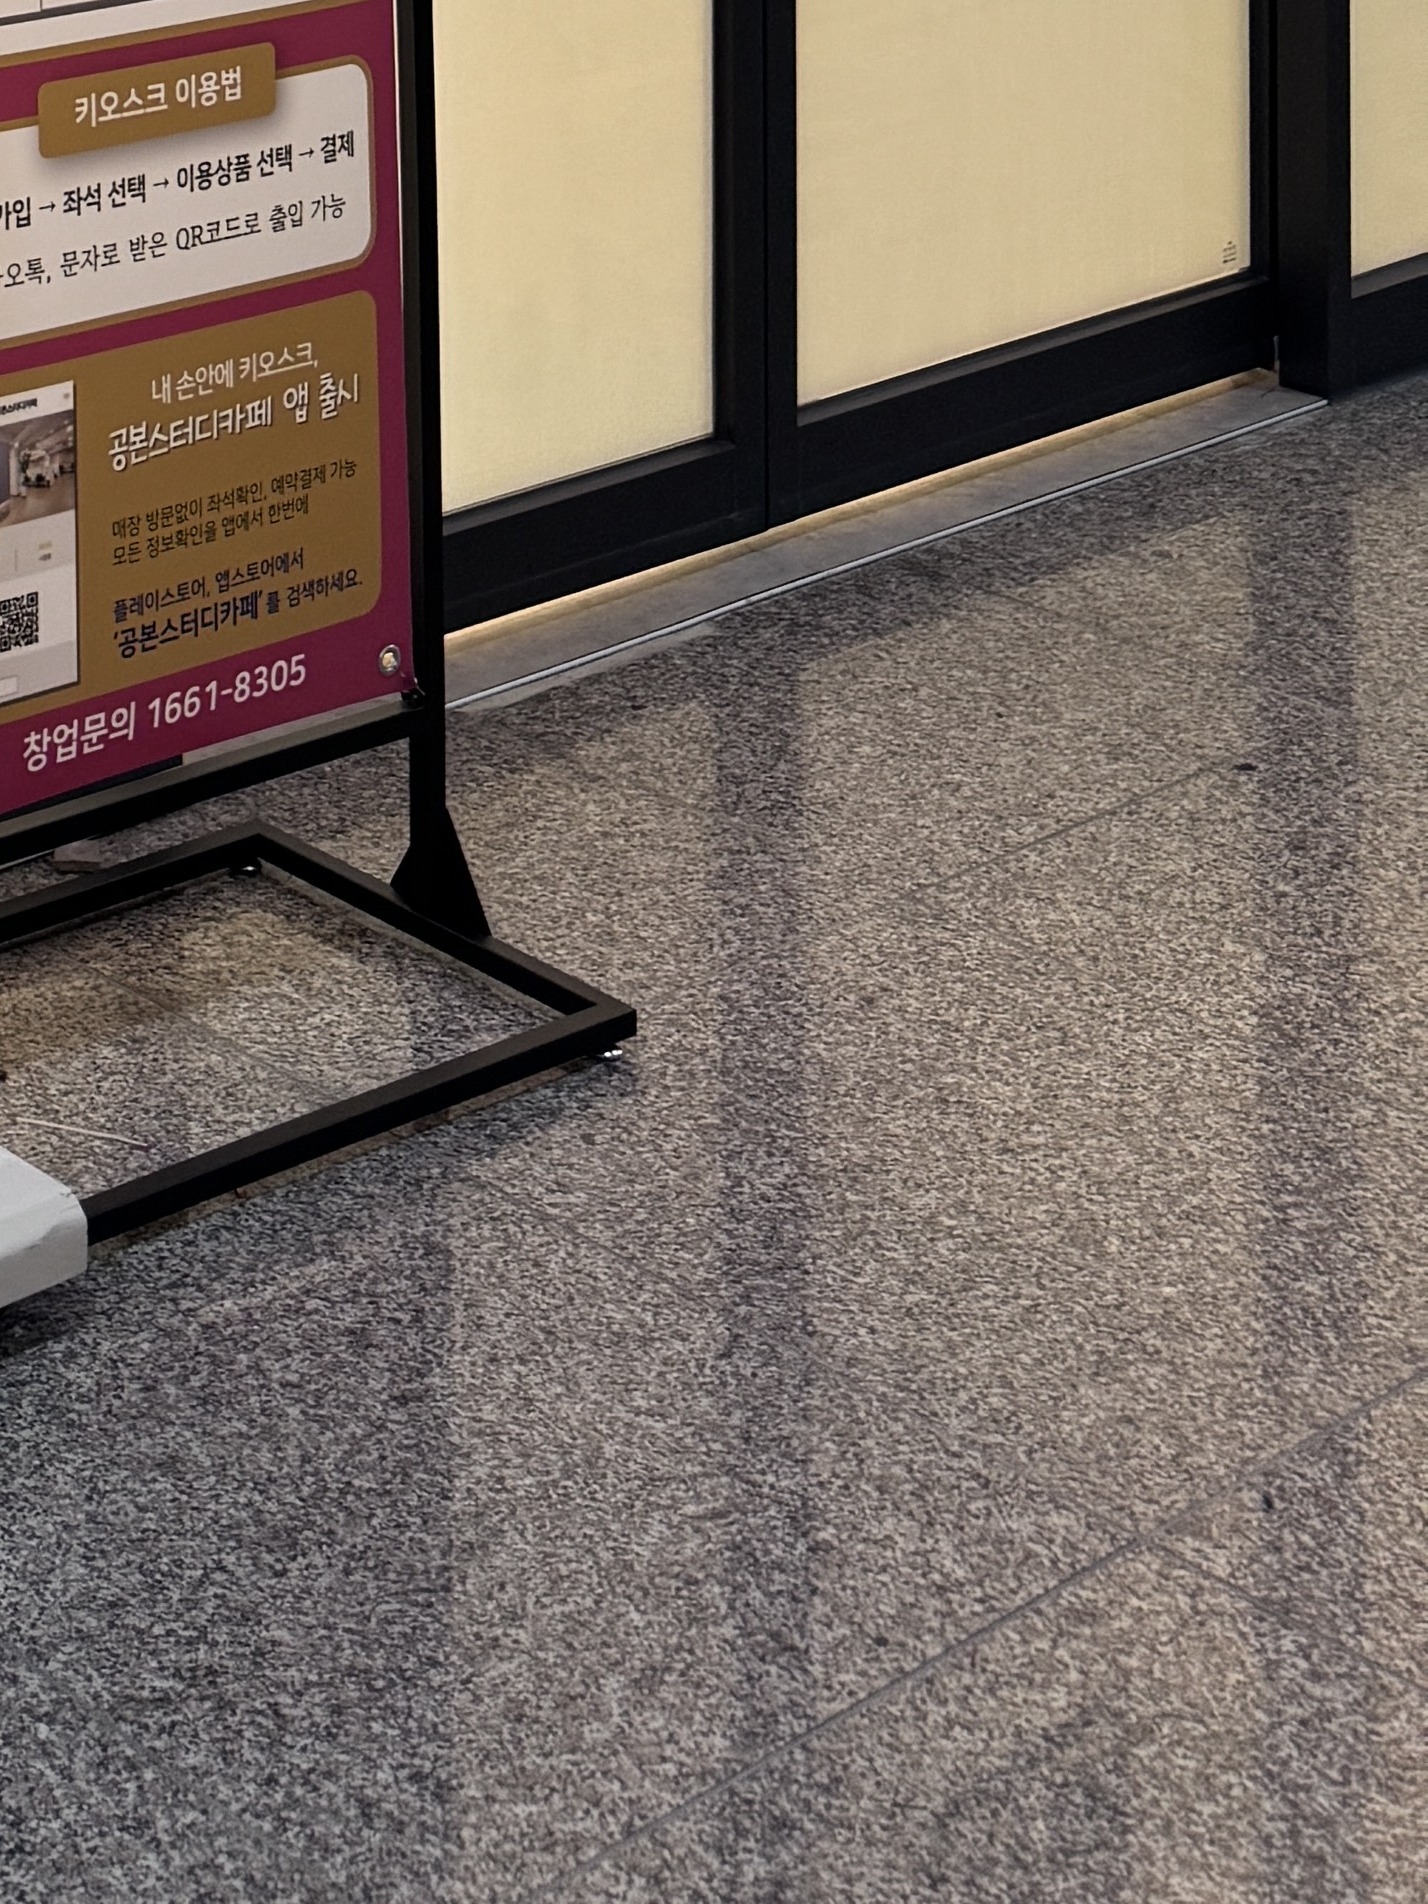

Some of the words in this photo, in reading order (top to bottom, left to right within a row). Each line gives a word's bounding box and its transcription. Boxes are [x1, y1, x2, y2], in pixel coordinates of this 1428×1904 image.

[75, 82, 168, 128] 키오스크
[175, 66, 243, 108] 이용법
[62, 185, 103, 215] 좌석
[108, 174, 146, 209] 선택
[176, 156, 251, 193] 이용상품
[256, 143, 293, 177] 선택
[319, 130, 355, 164] 결제
[60, 242, 120, 278] 문자로
[129, 233, 166, 263] 받은
[176, 212, 261, 252] QR코드로
[269, 201, 304, 234] 출입
[310, 193, 346, 222] 가능
[151, 377, 171, 405] 내
[176, 359, 234, 398] 손안에
[239, 342, 318, 384] 키오스크,
[108, 395, 272, 472] 공본스터디카페
[283, 386, 308, 423] 앱
[319, 373, 359, 420] 출시
[111, 511, 141, 539] 매장
[146, 497, 203, 532] 방문없이
[271, 467, 326, 500] 예약결제
[330, 459, 357, 483] 가능
[113, 542, 141, 567] 모든
[146, 523, 217, 560] 정보확인을
[222, 508, 263, 539] 앱에서
[268, 494, 309, 527] 한번에
[113, 576, 210, 624] 플레이스토어,
[215, 547, 304, 594] 앱스토어에서
[286, 568, 363, 606] 검색하세요.
[23, 701, 136, 773] 창업문의
[148, 654, 307, 729] 1661-8305
